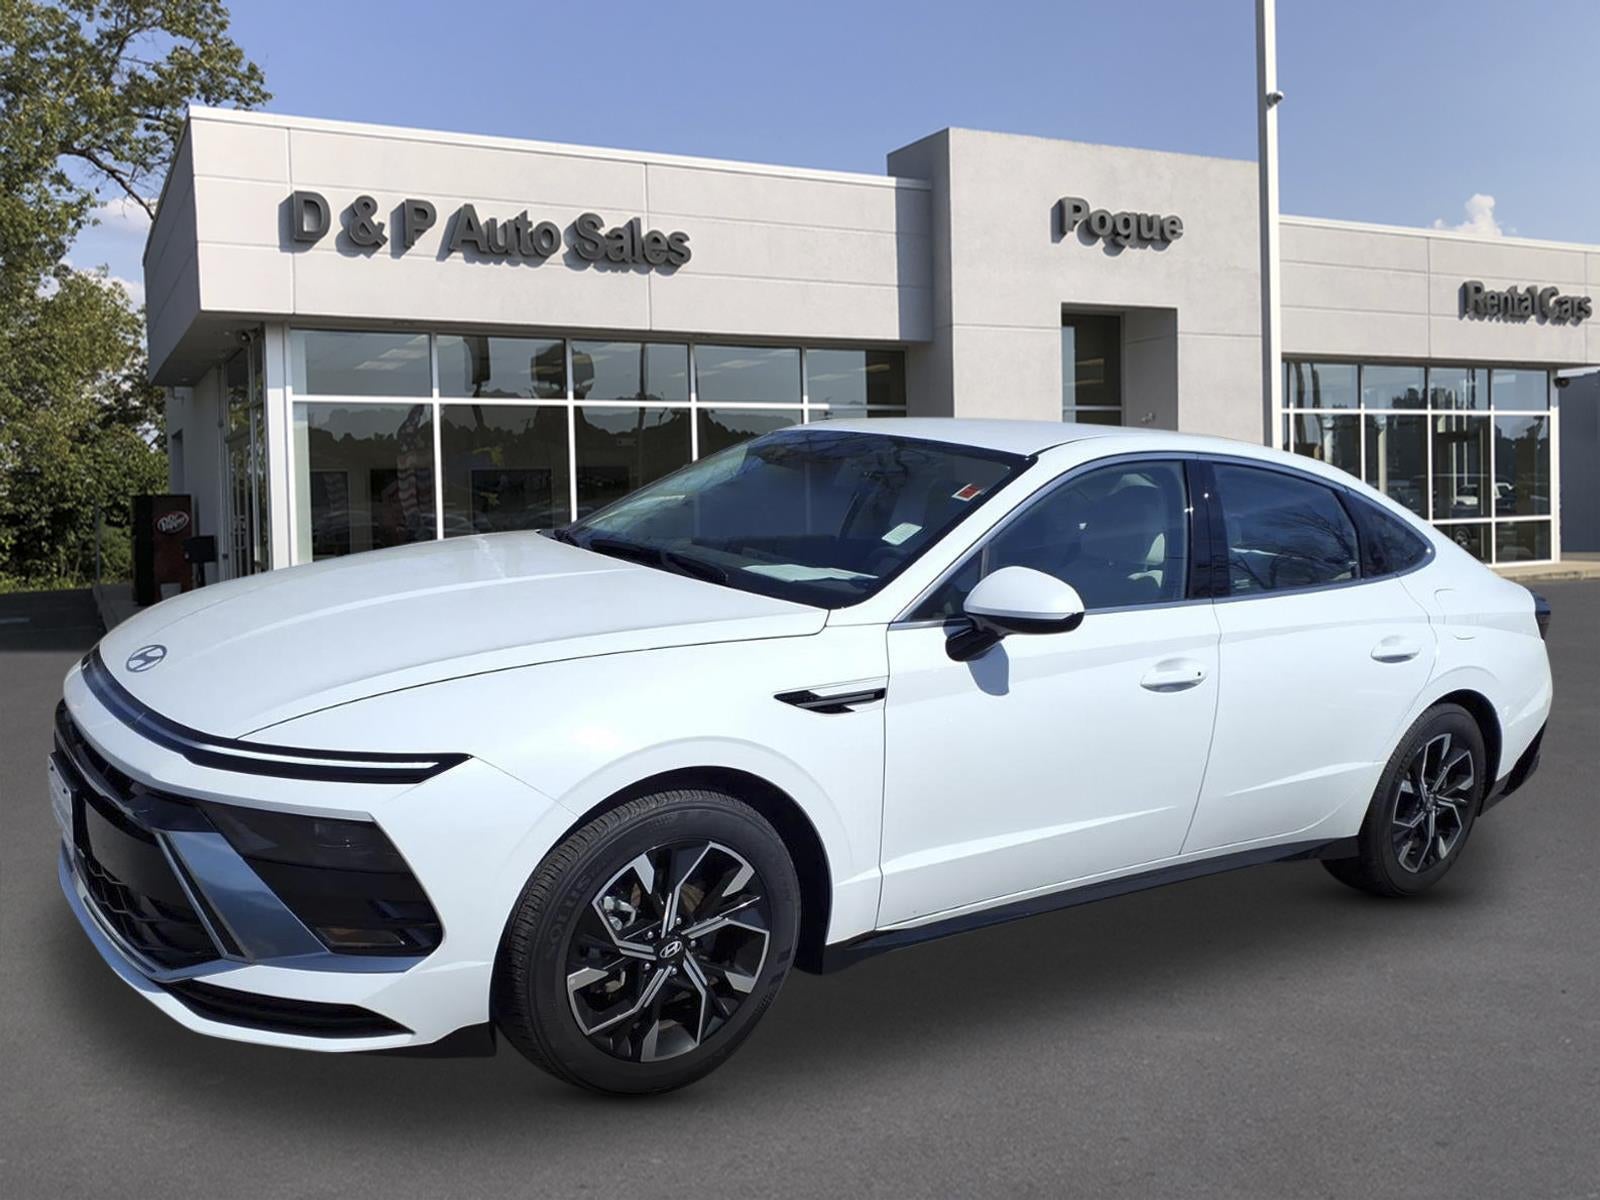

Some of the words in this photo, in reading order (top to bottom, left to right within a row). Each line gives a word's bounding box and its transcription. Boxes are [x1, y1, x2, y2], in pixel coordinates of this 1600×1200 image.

[292, 190, 332, 244] D
[350, 194, 389, 247] &
[403, 198, 438, 249] P
[449, 202, 562, 259] Auto
[573, 211, 692, 267] Sales
[1062, 196, 1184, 247] Pogue
[1464, 280, 1538, 319] Rental
[1539, 286, 1592, 321] Cars
